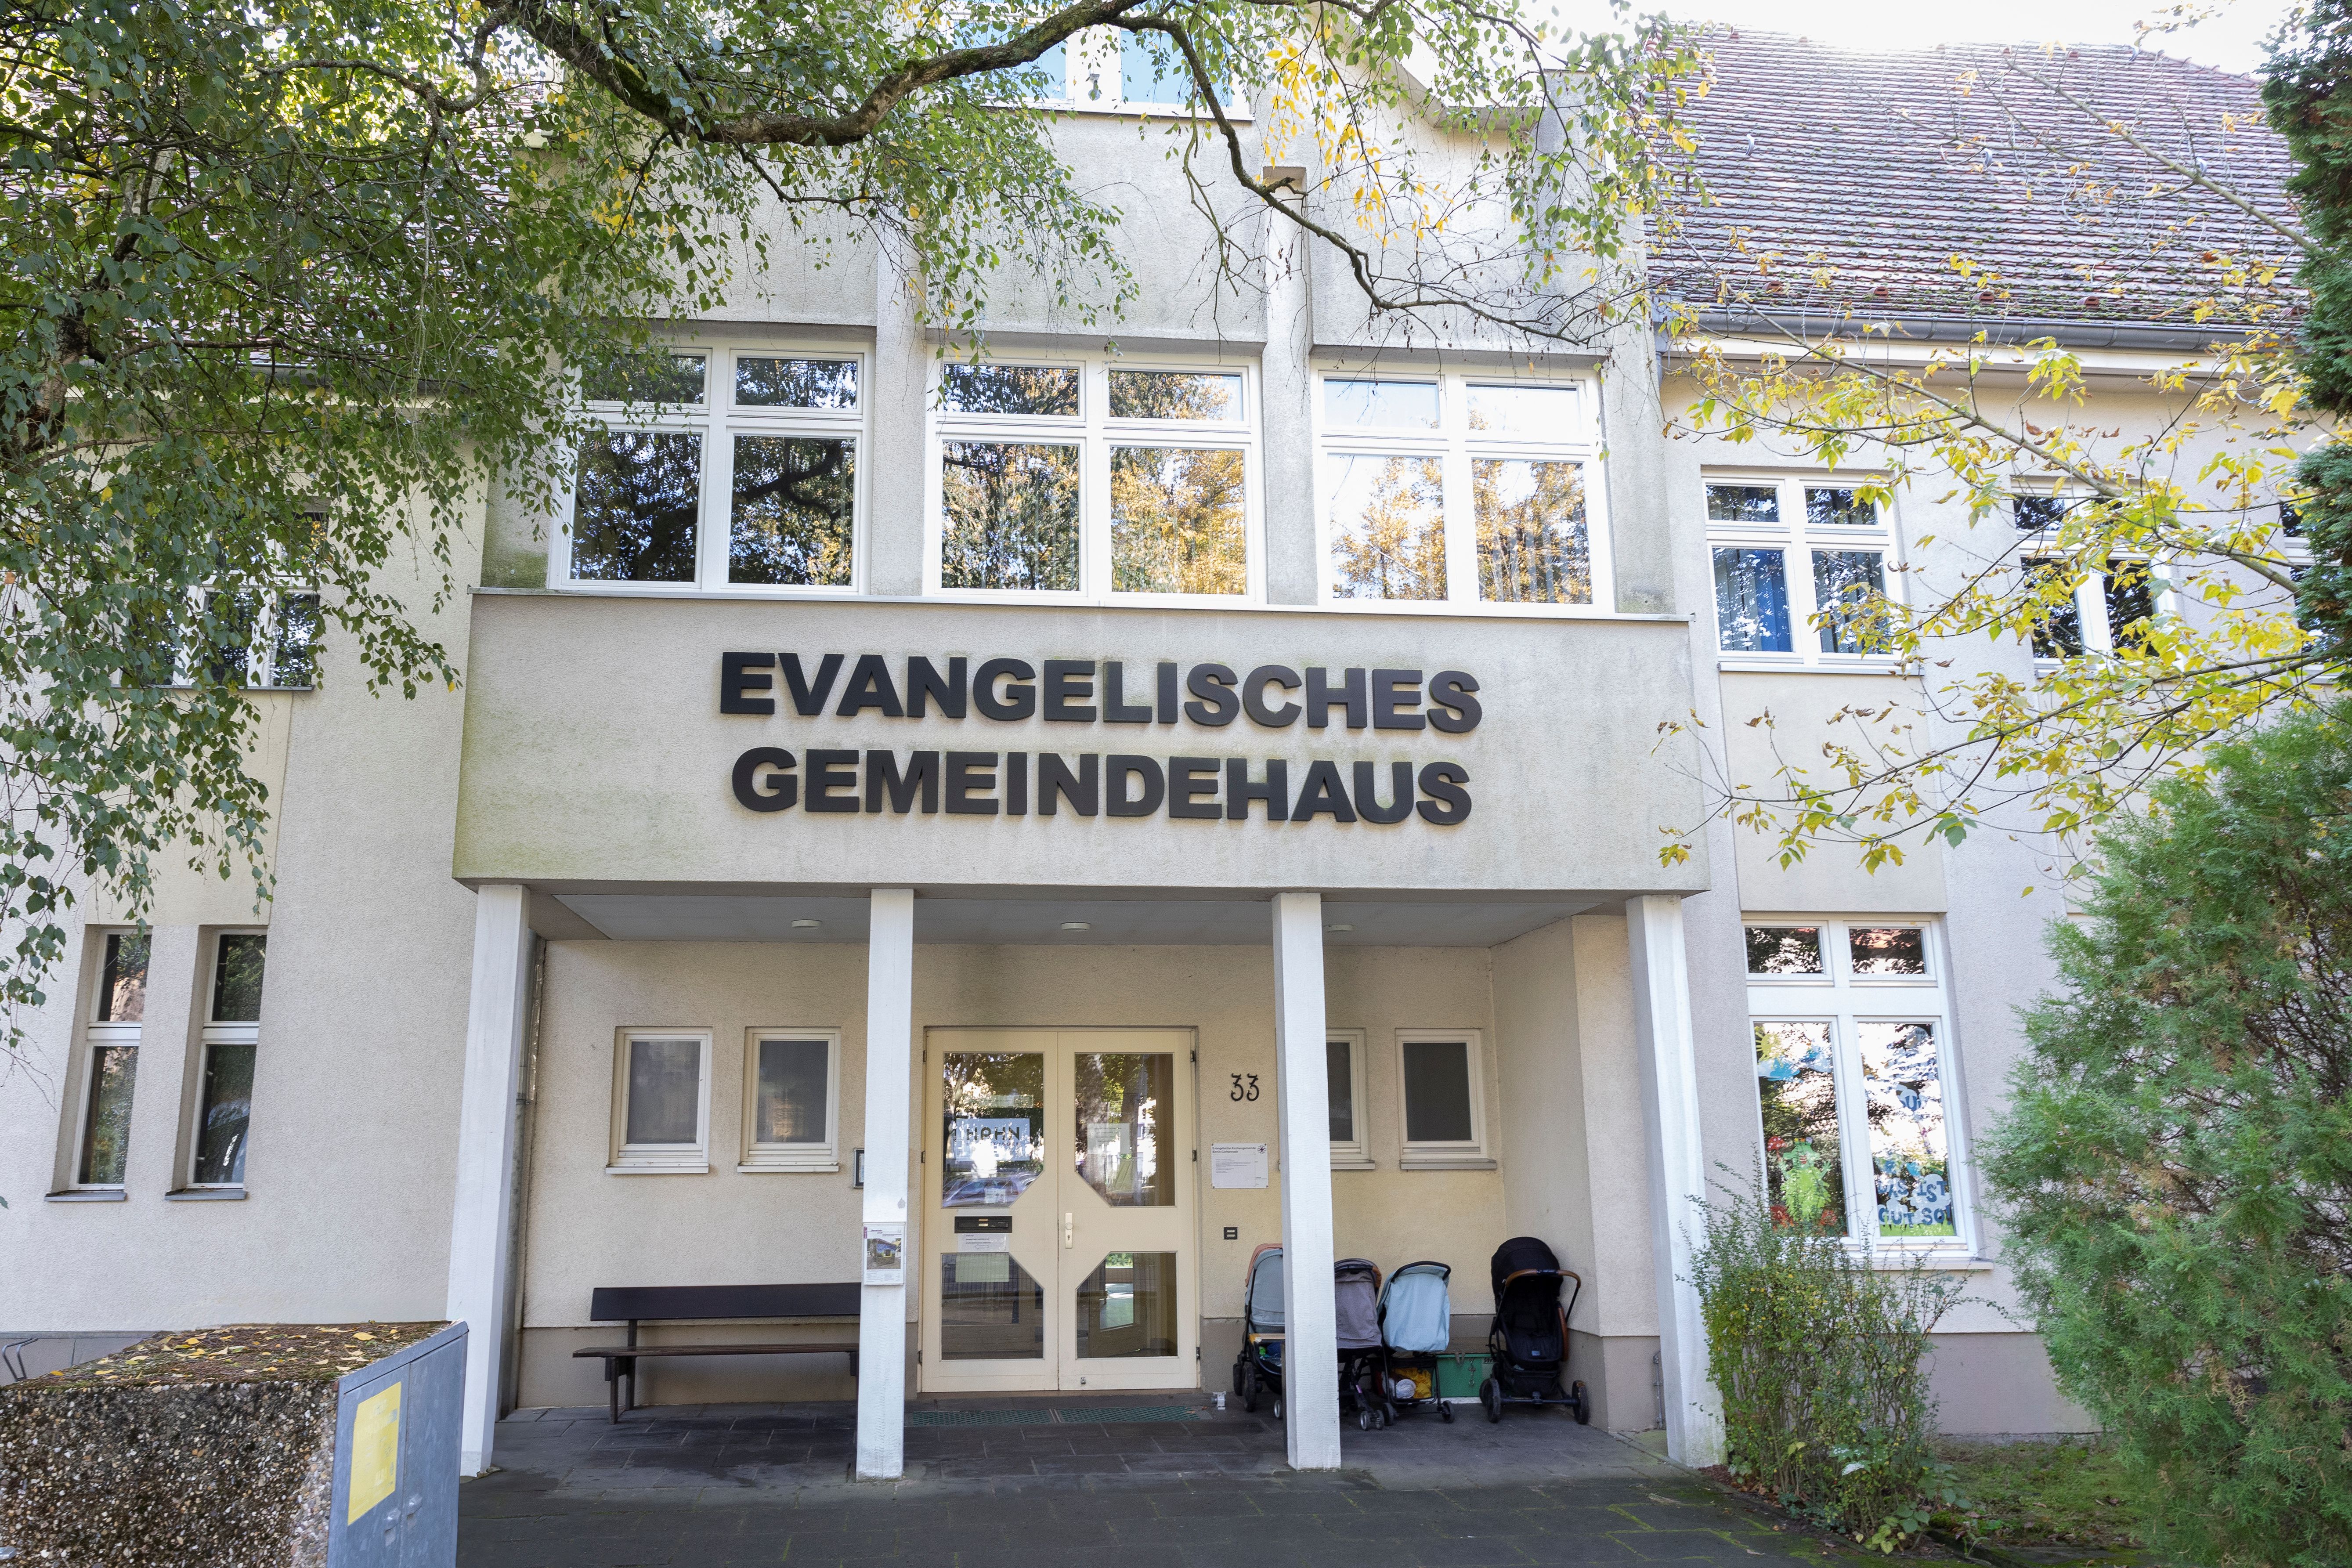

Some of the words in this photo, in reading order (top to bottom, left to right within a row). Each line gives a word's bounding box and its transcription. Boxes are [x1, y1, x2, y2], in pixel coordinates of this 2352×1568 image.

[720, 652, 1481, 733] EVANGELISCHES
[732, 747, 1471, 826] GEMEINDEHAUS
[1231, 1073, 1259, 1102] 33
[966, 1127, 1019, 1140] HAHN
[1916, 1180, 1947, 1202] IST
[1879, 1208, 1915, 1228] GUT
[1922, 1205, 1951, 1225] SO!
